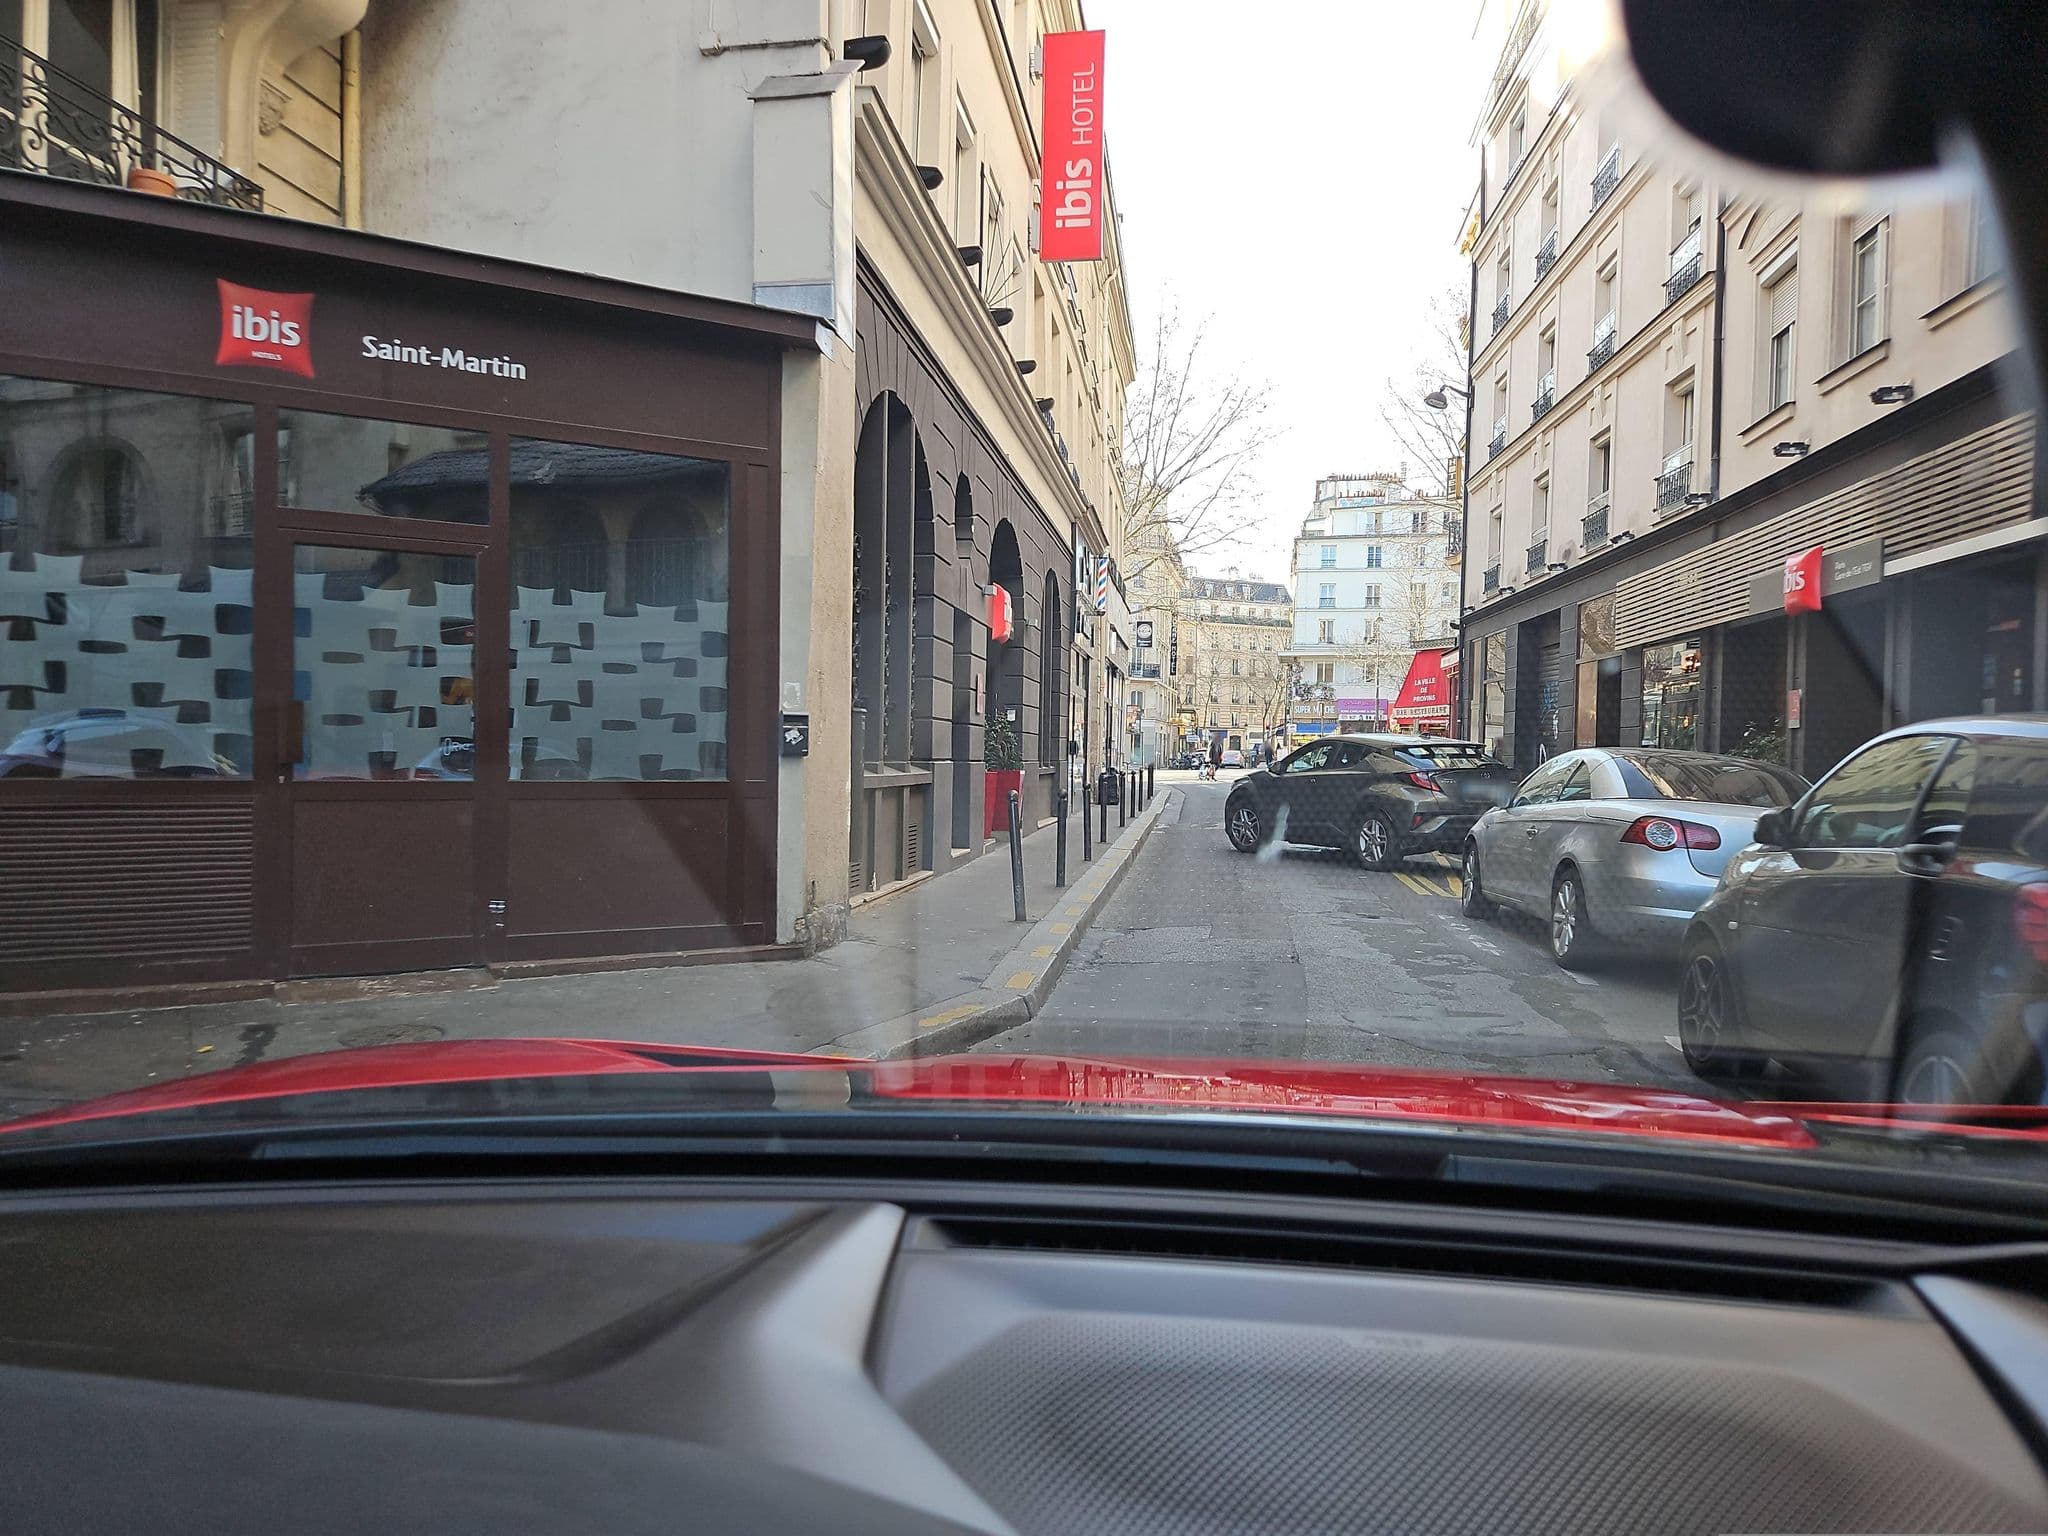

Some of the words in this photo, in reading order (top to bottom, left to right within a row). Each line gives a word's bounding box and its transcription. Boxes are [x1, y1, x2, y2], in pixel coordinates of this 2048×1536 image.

[1072, 61, 1095, 145] HOTEL
[1055, 158, 1093, 229] ibis
[231, 305, 301, 347] ibis
[361, 335, 527, 380] Saint-Martin
[1783, 566, 1806, 594] bis
[1413, 694, 1436, 702] PROVINS
[1422, 677, 1437, 685] VILLE
[1295, 705, 1312, 714] SUPER
